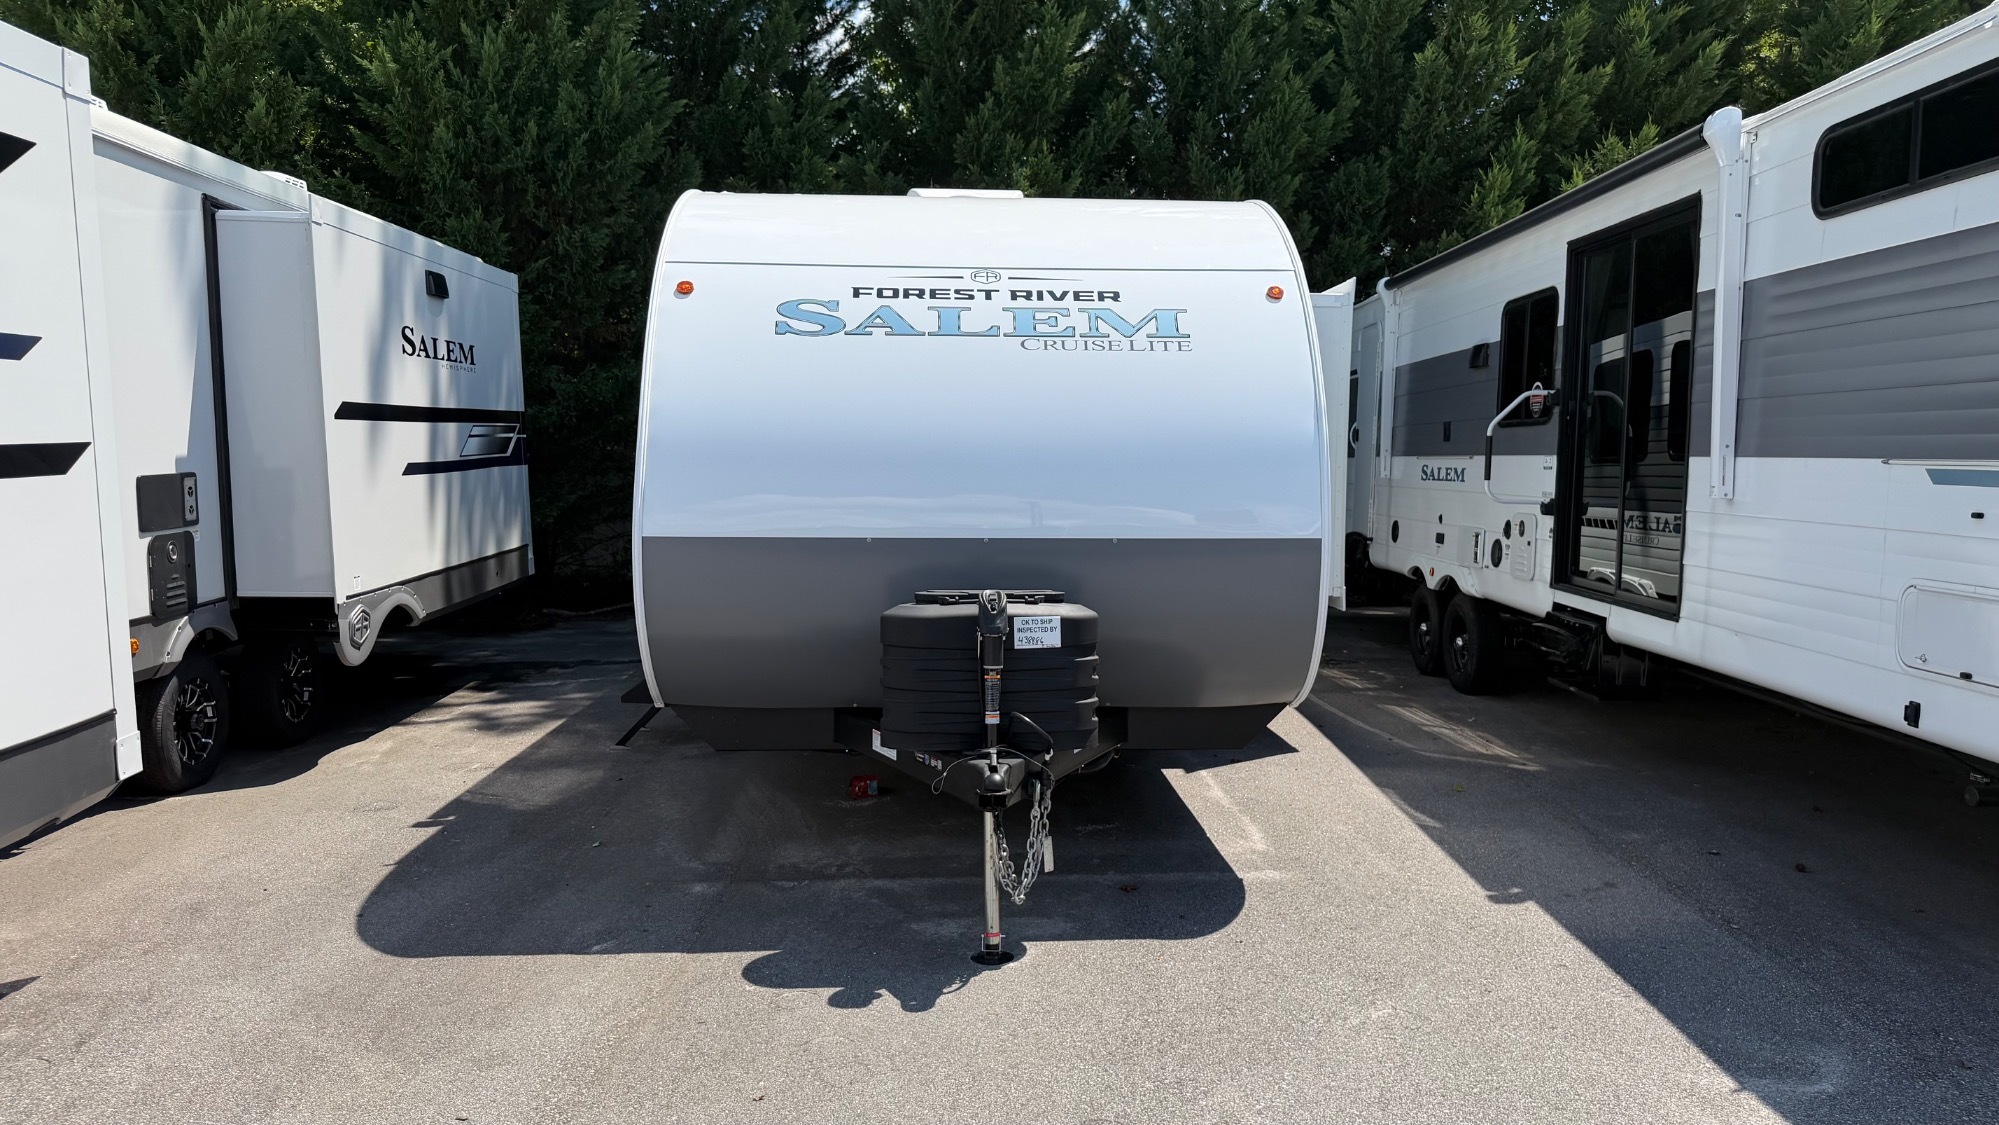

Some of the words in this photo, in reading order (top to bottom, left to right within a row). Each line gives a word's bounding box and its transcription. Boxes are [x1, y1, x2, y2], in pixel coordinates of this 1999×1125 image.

[851, 286, 1000, 301] FOREST
[1008, 289, 1121, 302] RIVER
[775, 299, 1191, 338] SALEM
[401, 325, 476, 366] SALEM
[441, 363, 477, 374] HEMISPHERE
[1420, 464, 1466, 482] SALEM
